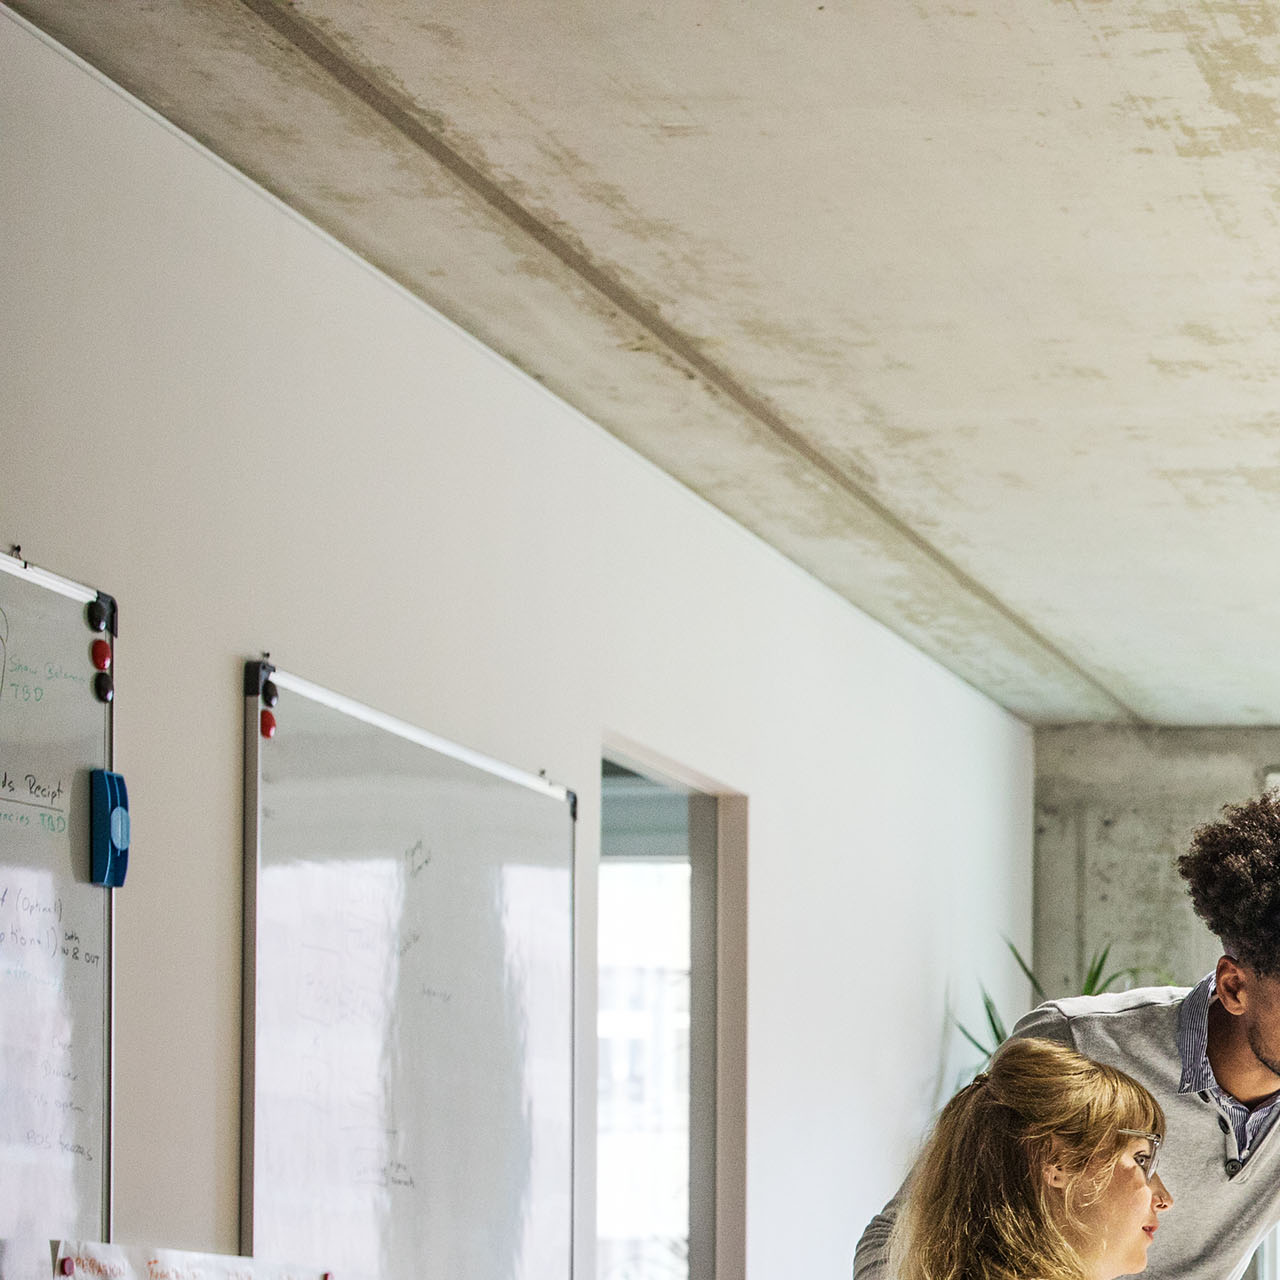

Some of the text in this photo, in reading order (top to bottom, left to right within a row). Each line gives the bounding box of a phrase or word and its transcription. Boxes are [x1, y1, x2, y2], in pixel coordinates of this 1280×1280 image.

[10, 684, 44, 702] TBD
[40, 812, 67, 833] TBD
[84, 951, 100, 968] OUT
